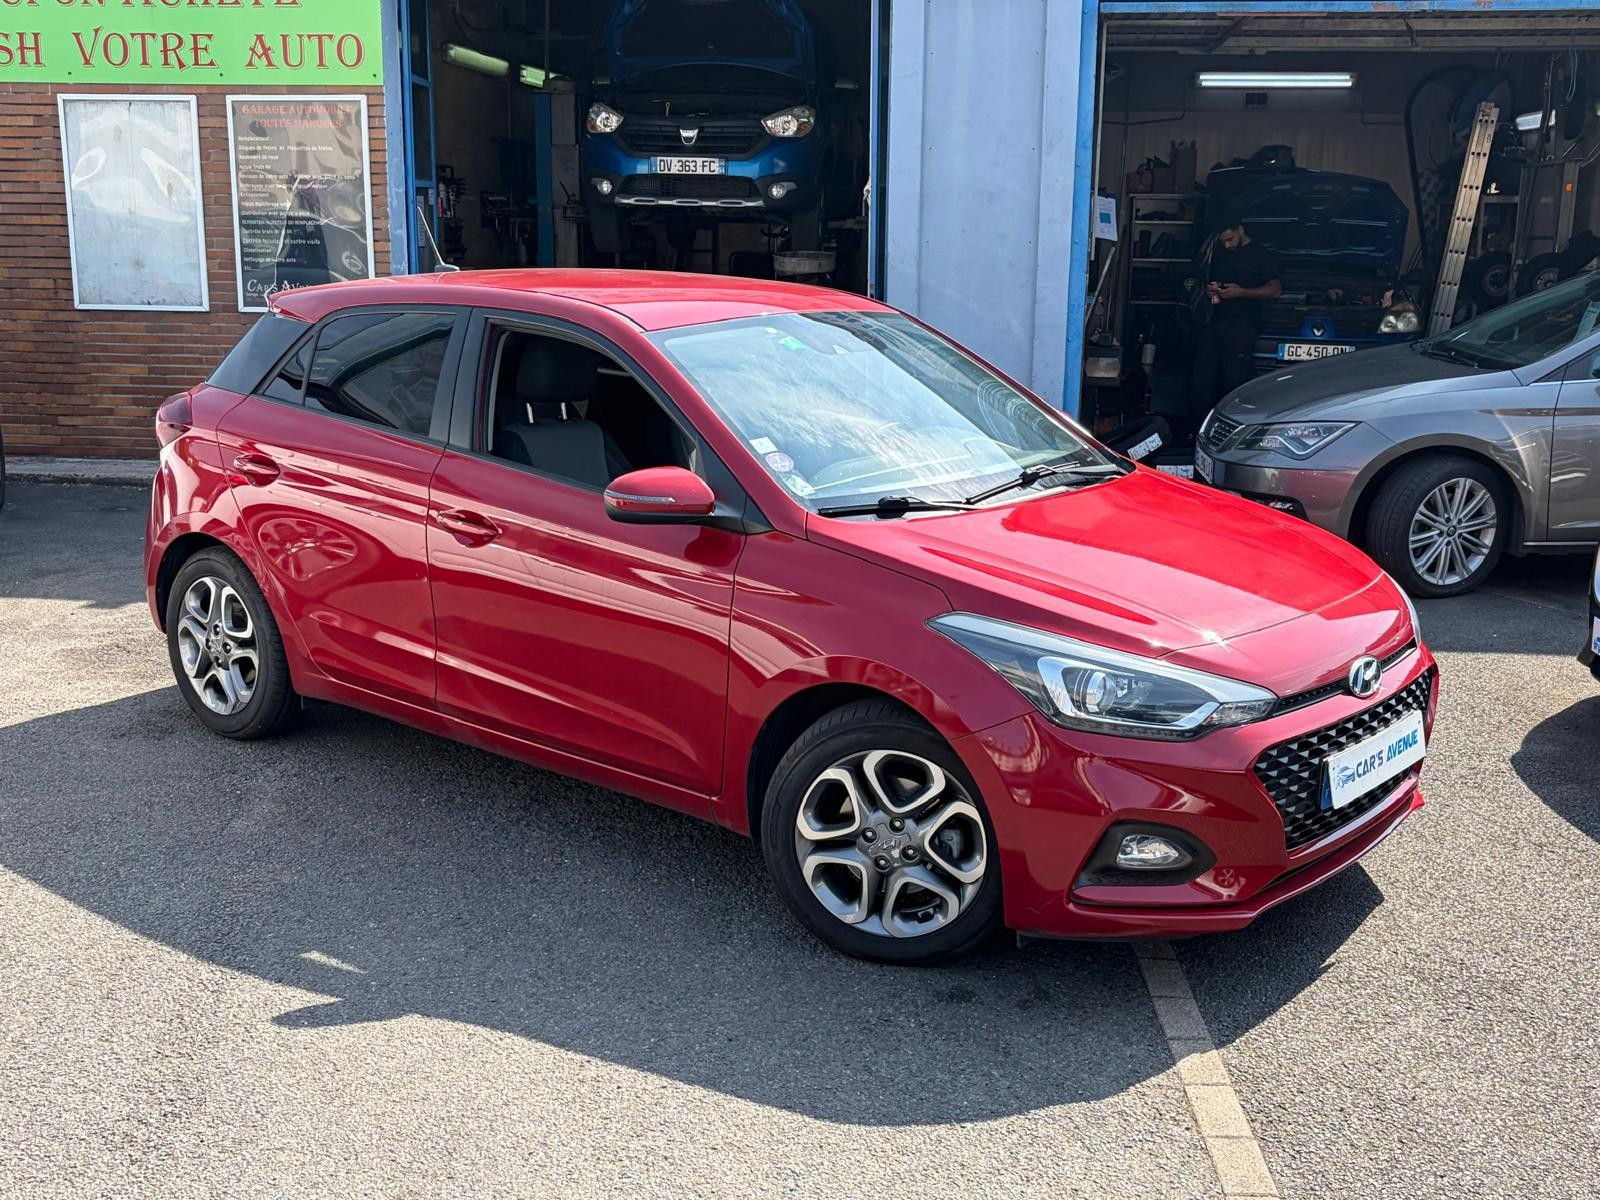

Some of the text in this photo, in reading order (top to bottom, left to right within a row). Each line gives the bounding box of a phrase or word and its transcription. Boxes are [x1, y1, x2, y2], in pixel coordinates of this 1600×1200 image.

[72, 26, 218, 71] VOTRE
[244, 33, 365, 69] AUTO
[242, 105, 287, 114] GARAGE
[1356, 729, 1418, 778] CAR'S AVENUE
